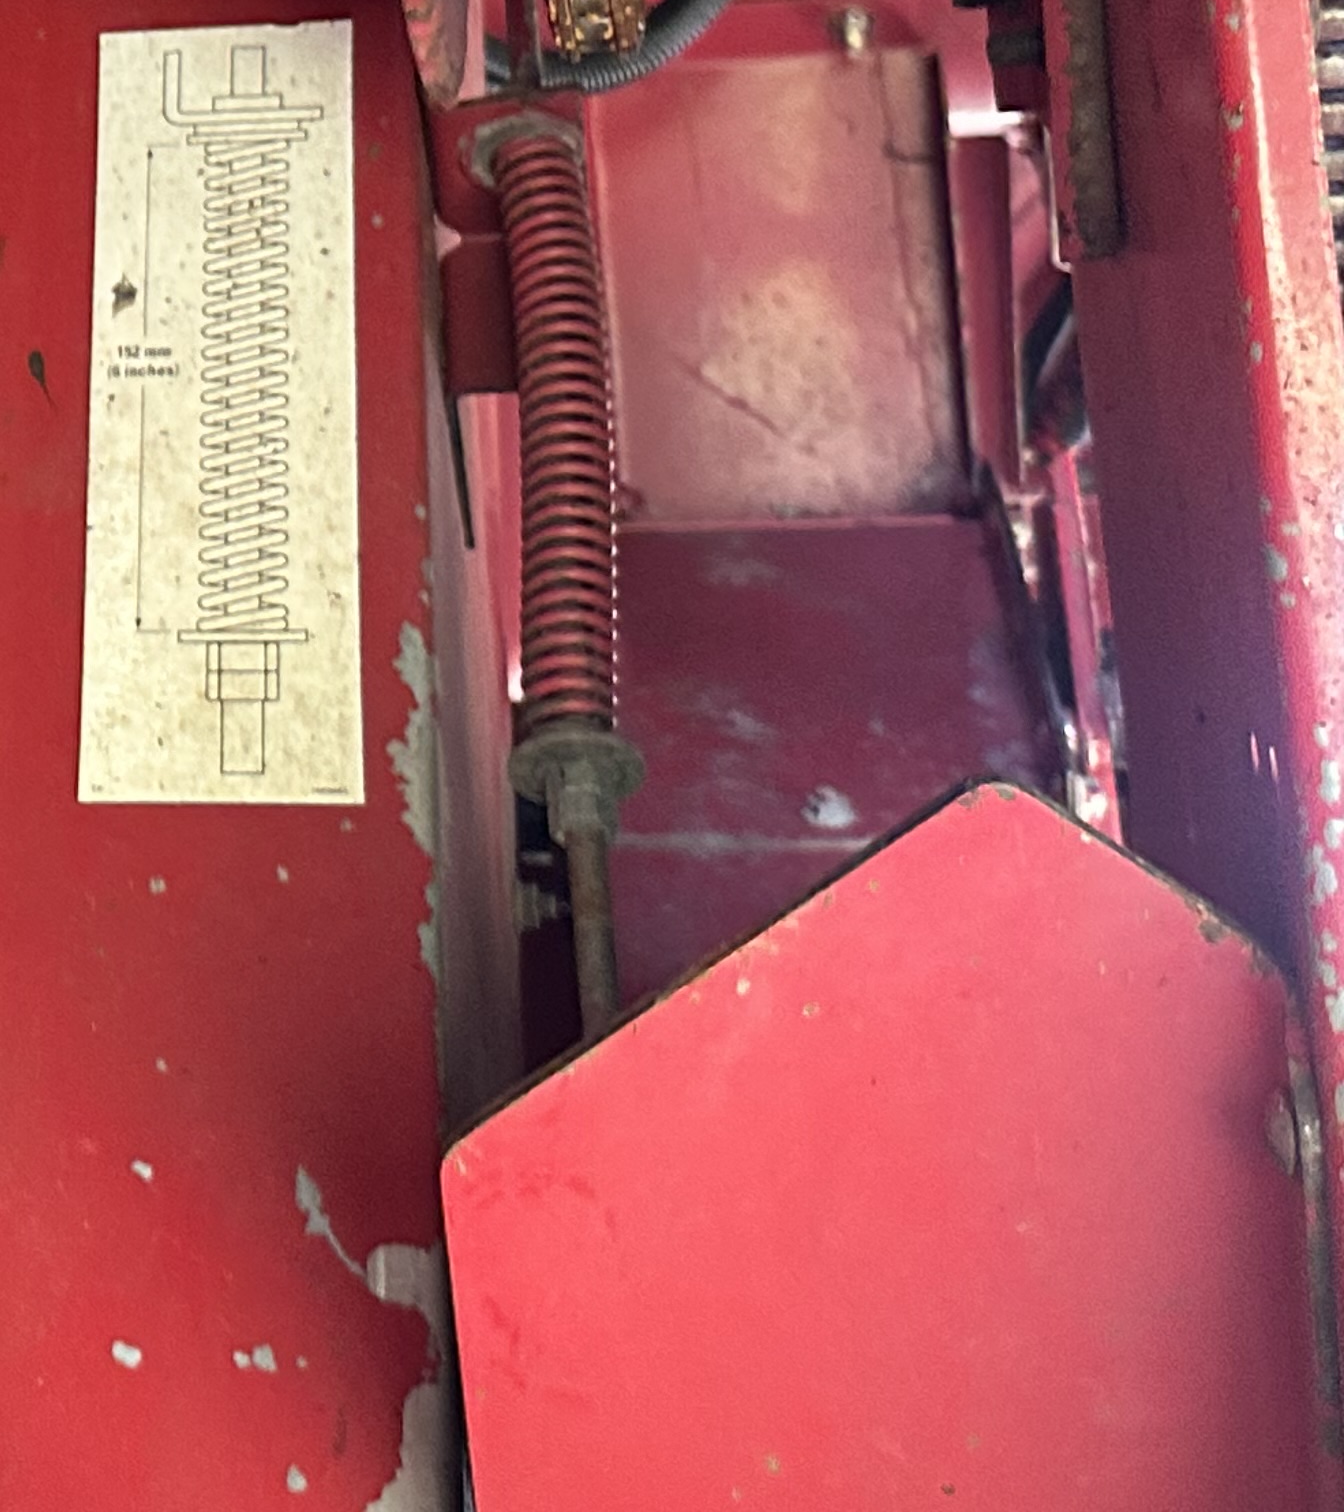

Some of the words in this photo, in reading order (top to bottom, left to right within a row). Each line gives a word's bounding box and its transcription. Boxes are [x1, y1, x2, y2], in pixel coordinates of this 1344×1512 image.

[117, 344, 140, 359] 152
[144, 347, 172, 358] mm
[124, 361, 180, 378] inches)
